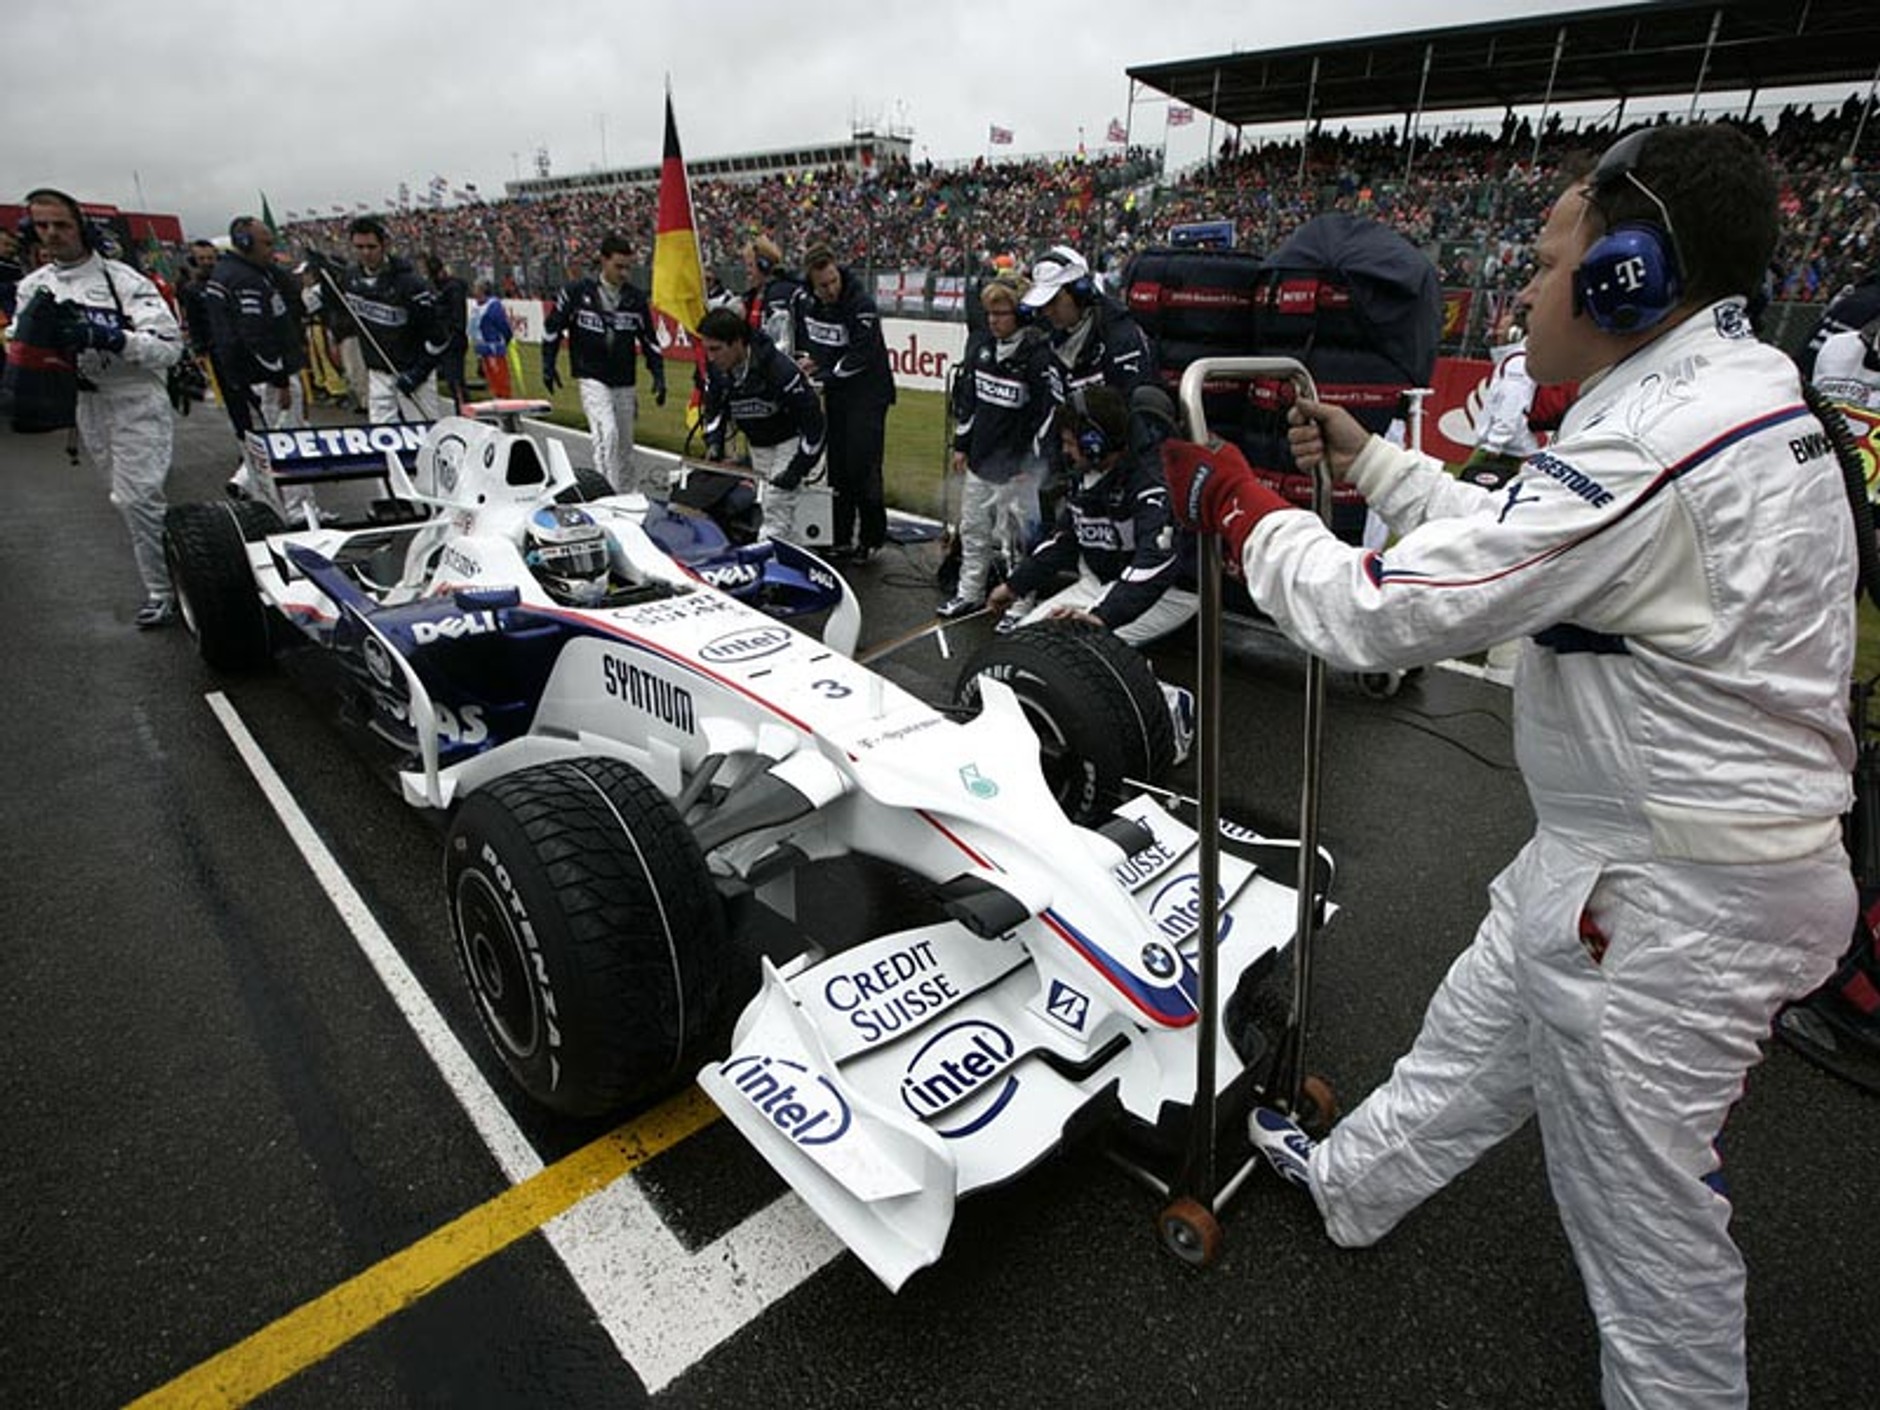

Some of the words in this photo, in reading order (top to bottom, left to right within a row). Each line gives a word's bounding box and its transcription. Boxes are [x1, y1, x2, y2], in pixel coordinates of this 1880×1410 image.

[709, 631, 784, 657] intel
[603, 653, 695, 735] SYNTIUM
[811, 679, 853, 700] 3
[481, 843, 561, 1047] POTENZA
[825, 940, 938, 1012] CREDIT
[850, 973, 960, 1043] SUISSE
[735, 1056, 831, 1139] intel
[904, 1034, 1007, 1109] intel
